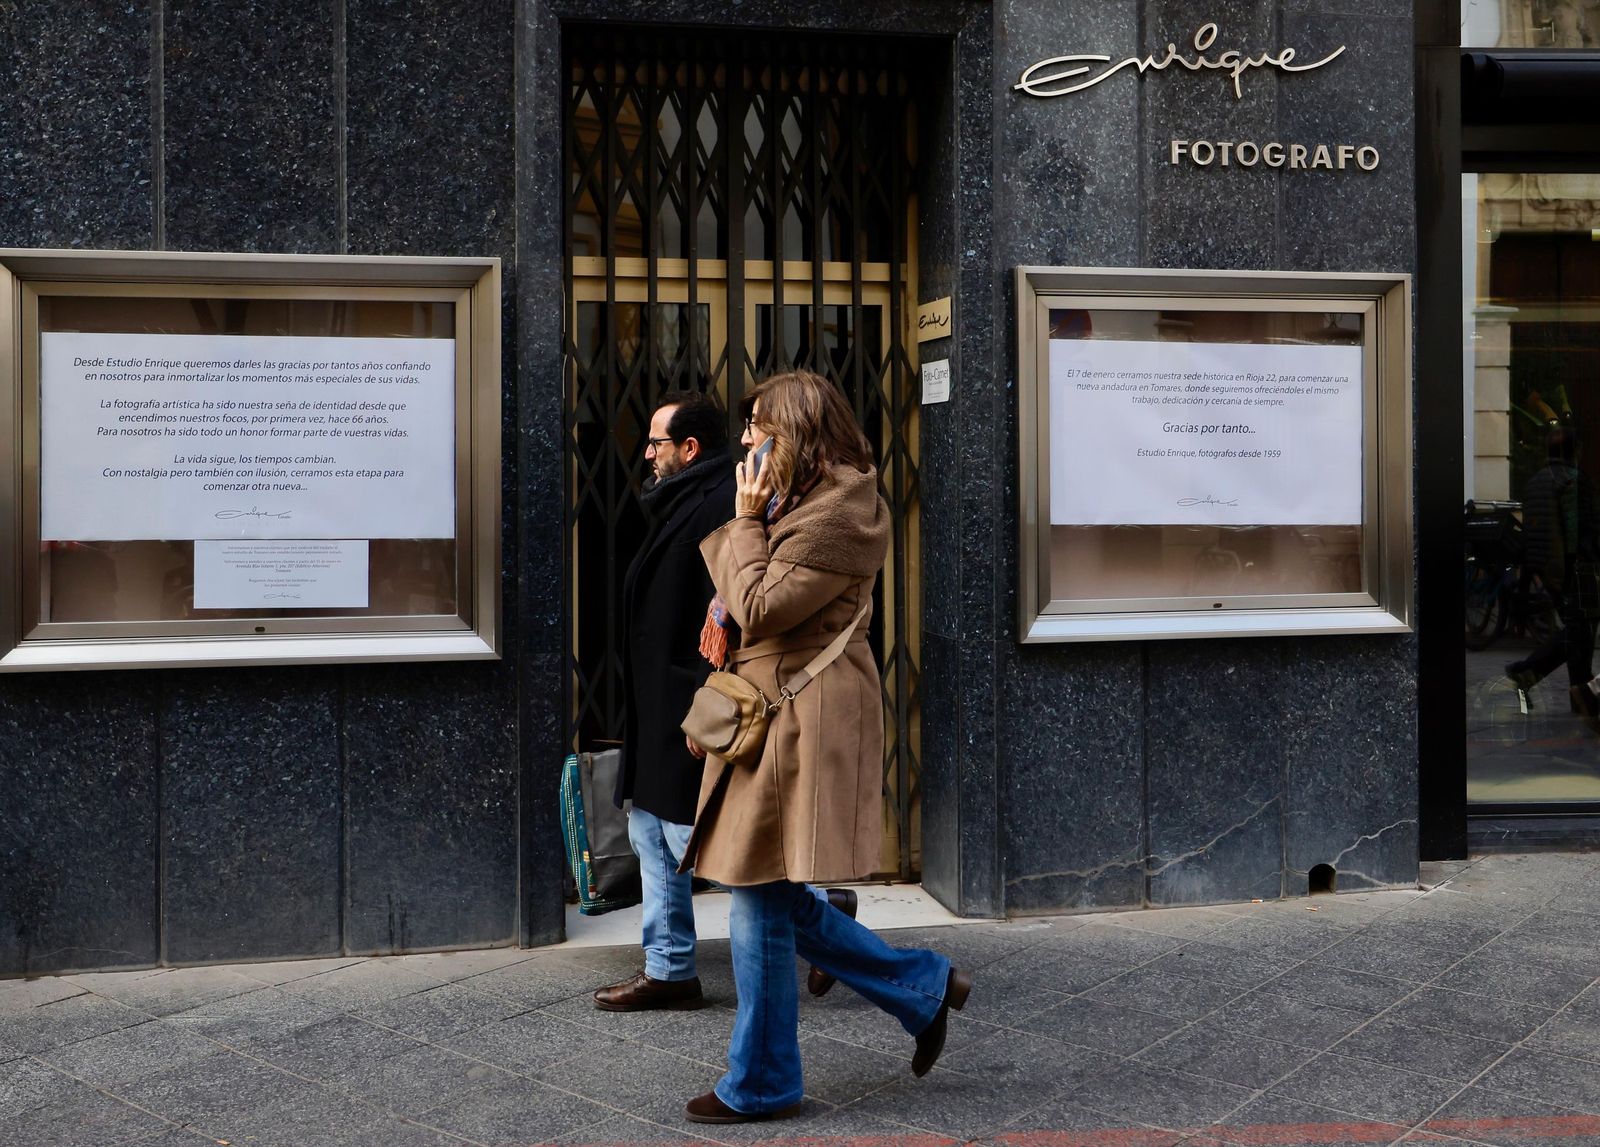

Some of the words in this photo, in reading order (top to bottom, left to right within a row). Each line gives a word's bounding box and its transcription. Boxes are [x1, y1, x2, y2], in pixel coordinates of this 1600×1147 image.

[1013, 22, 1347, 99] Enrique
[1170, 139, 1381, 171] FOTOGRAFO
[73, 358, 104, 367] Desde
[105, 358, 143, 368] Estudio
[143, 359, 182, 371] Enrique
[182, 361, 232, 371] queremos
[232, 359, 262, 369] darles
[263, 360, 276, 369] las
[277, 360, 311, 372] gracias
[312, 362, 329, 372] por
[330, 360, 360, 370] tantos
[361, 361, 384, 370] años
[384, 361, 431, 370] confiando
[98, 372, 142, 381] nosotros
[143, 374, 165, 384] para
[166, 372, 225, 382] inmortalizar
[225, 373, 240, 382] los
[241, 373, 293, 383] momentos
[294, 374, 314, 383] más
[314, 374, 363, 386] especiales
[363, 374, 377, 383] de
[377, 376, 393, 384] sus
[394, 374, 420, 384] vidas.
[1066, 370, 1074, 378] El
[1075, 370, 1080, 378] 7
[1080, 370, 1092, 378] de
[1153, 371, 1182, 379] nuestra
[1182, 372, 1202, 380] sede
[1202, 372, 1234, 380] histórica
[1245, 372, 1265, 383] Rioja
[1265, 373, 1278, 383] 22,
[1278, 375, 1296, 383] para
[1100, 382, 1138, 391] andadura
[1148, 384, 1184, 394] Tomares,
[1183, 384, 1211, 392] donde
[1210, 384, 1254, 395] seguiremos
[1253, 385, 1305, 394] ofreciéndoles
[1305, 386, 1313, 394] el
[1313, 386, 1339, 394] mismo
[99, 399, 112, 408] La
[112, 399, 161, 411] fotografía
[161, 399, 200, 409] artística
[201, 400, 214, 409] ha
[215, 400, 237, 409] sido
[237, 400, 273, 409] nuestra
[274, 400, 297, 410] seña
[298, 400, 311, 410] de
[312, 401, 357, 410] identidad
[358, 401, 387, 410] desde
[387, 403, 407, 413] que
[1131, 395, 1161, 406] trabajo,
[1160, 395, 1204, 405] dedicación
[1203, 398, 1211, 407] y
[1210, 397, 1242, 405] cercanía
[1242, 397, 1253, 405] de
[1253, 397, 1285, 408] siempre.
[118, 413, 178, 422] encendimos
[178, 413, 220, 422] nuestros
[221, 413, 250, 425] focos,
[251, 416, 268, 425] por
[269, 414, 306, 425] primera
[307, 416, 326, 426] vez,
[327, 414, 350, 423] hace
[351, 414, 364, 423] 66
[364, 414, 389, 423] años.
[96, 426, 118, 435] Para
[119, 426, 162, 436] nosotros
[163, 427, 176, 436] ha
[177, 427, 199, 436] sido
[199, 427, 223, 436] todo
[239, 427, 268, 436] honor
[269, 427, 301, 436] formar
[302, 427, 328, 439] parte
[329, 427, 342, 437] de
[343, 427, 382, 437] vuestras
[382, 428, 409, 437] vidas.
[1161, 422, 1199, 433] Gracias
[1200, 425, 1220, 437] por
[1220, 422, 1256, 434] tanto...
[173, 454, 185, 463] La
[186, 454, 207, 463] vida
[208, 454, 237, 466] sigue,
[238, 454, 253, 463] los
[253, 454, 293, 466] tiempos
[293, 454, 337, 464] cambian.
[1136, 448, 1166, 457] Estudio
[1166, 448, 1197, 460] Enrique,
[1197, 448, 1238, 460] fotógrafos
[1237, 448, 1262, 457] desde
[1263, 448, 1281, 458] 1959
[101, 468, 122, 477] Con
[123, 468, 168, 479] nostalgia
[169, 470, 193, 479] pero
[193, 468, 234, 477] también
[254, 468, 289, 479] ilusión,
[334, 468, 354, 477] esta
[355, 468, 382, 479] etapa
[383, 470, 404, 479] para
[250, 481, 271, 490] otra
